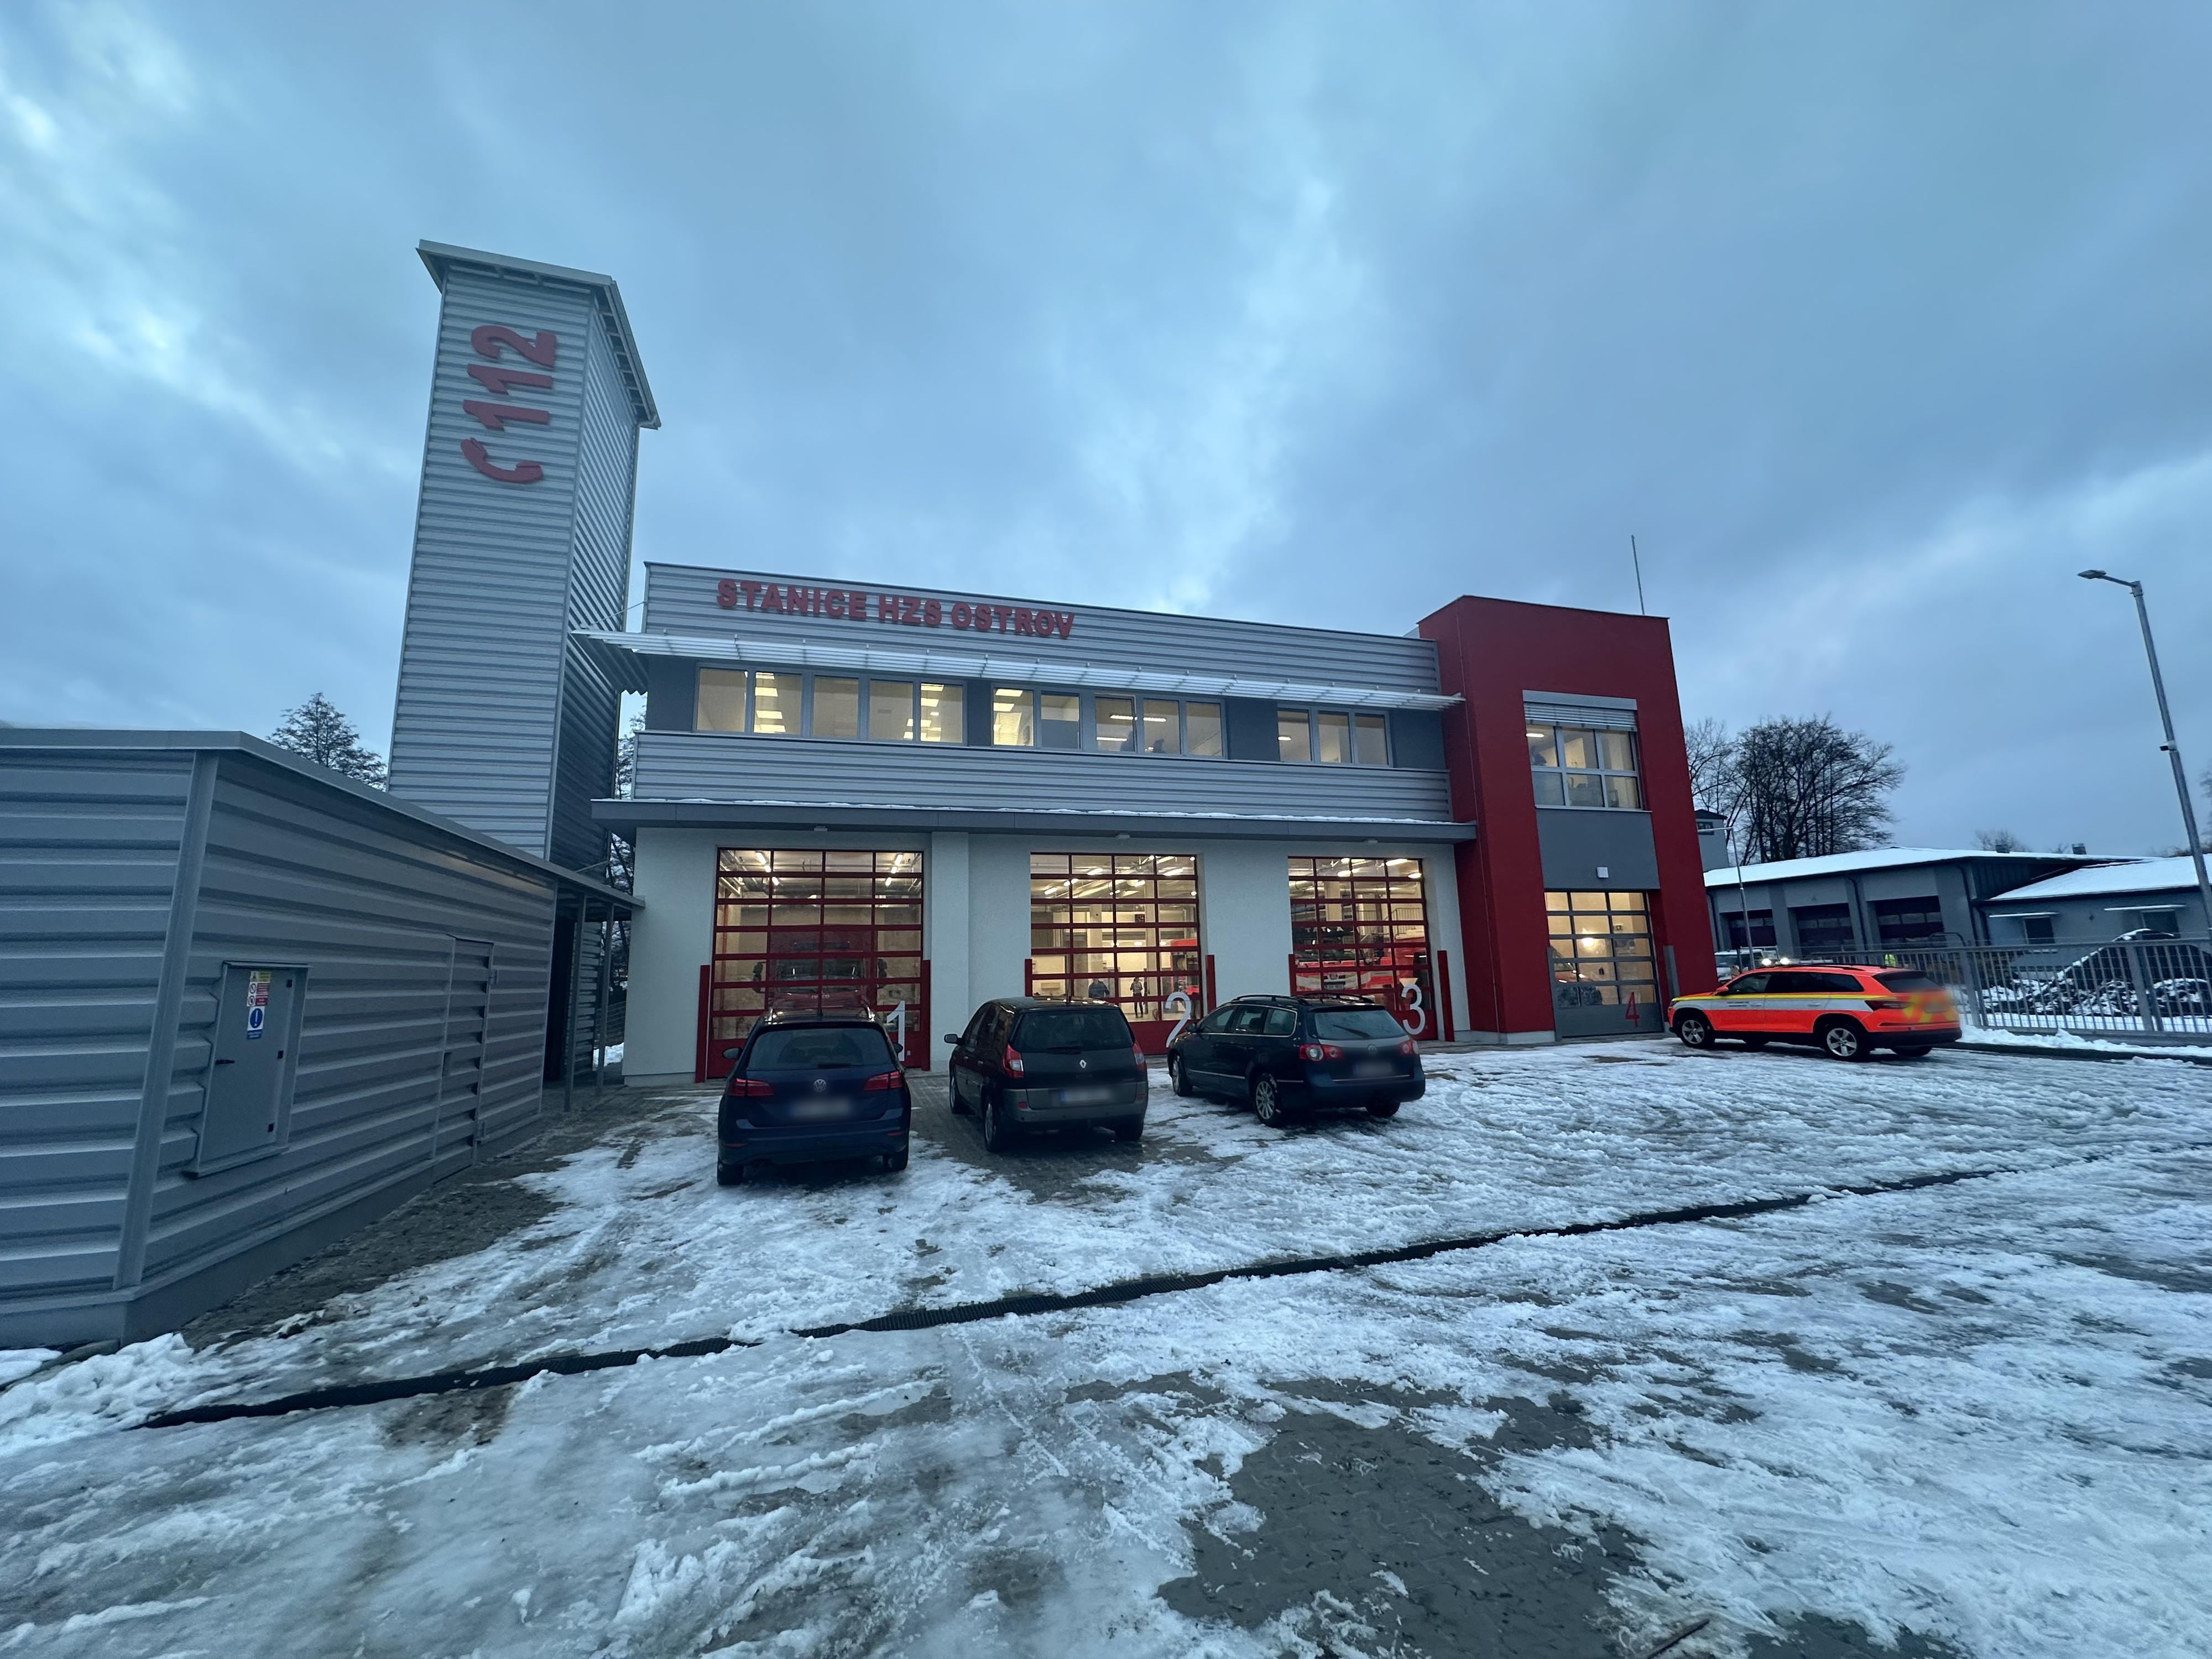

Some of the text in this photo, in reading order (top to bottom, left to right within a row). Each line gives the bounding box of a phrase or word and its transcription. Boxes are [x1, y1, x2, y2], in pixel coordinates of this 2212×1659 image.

[462, 325, 557, 431] 112
[717, 578, 1075, 639] STANICE HZS OSTROV
[886, 1000, 905, 1061] 1
[1165, 992, 1191, 1048] 2
[1401, 984, 1425, 1035] 3
[1625, 991, 1640, 1027] 4
